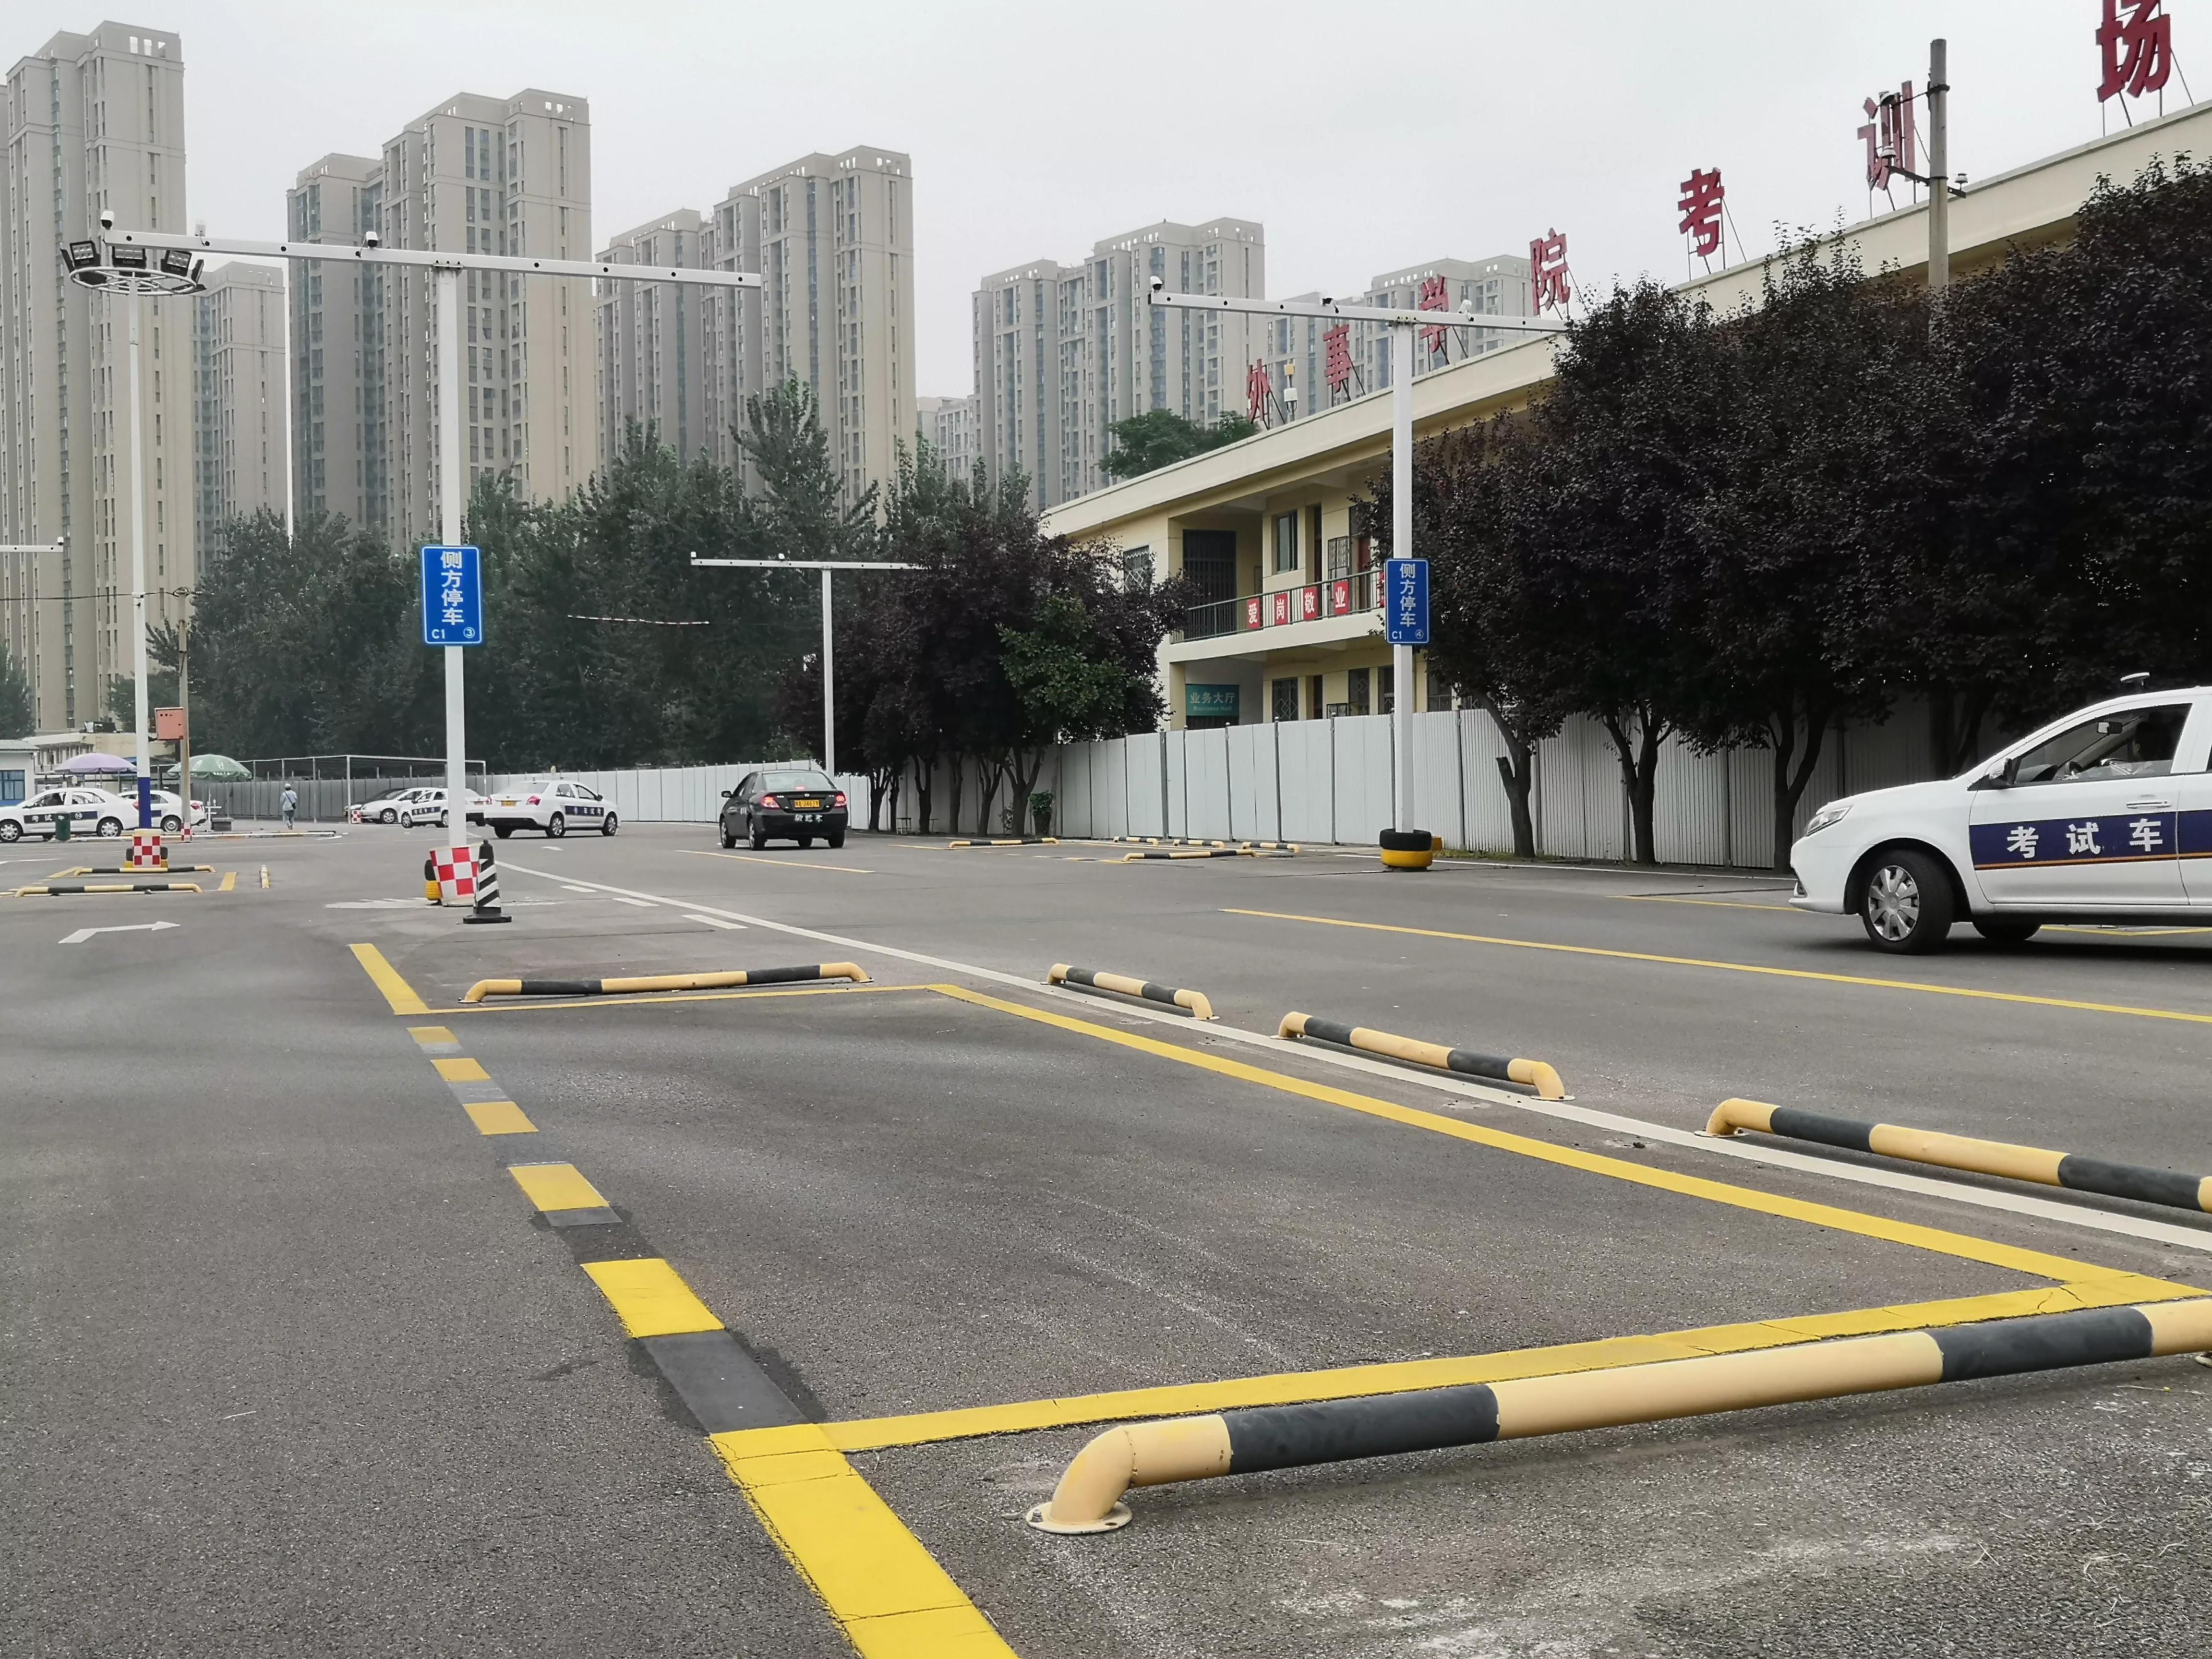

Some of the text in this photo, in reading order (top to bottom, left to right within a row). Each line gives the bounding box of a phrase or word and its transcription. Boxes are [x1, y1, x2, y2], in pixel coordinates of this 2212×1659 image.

[441, 551, 464, 625] 侧方停车
[1248, 586, 1346, 624] 爱岗敬业
[1399, 563, 1416, 627] 侧方停车
[432, 629, 445, 639] C1
[1392, 630, 1402, 639] C1
[1190, 692, 1235, 704] 业务大厅
[2007, 818, 2163, 858] 考试车
